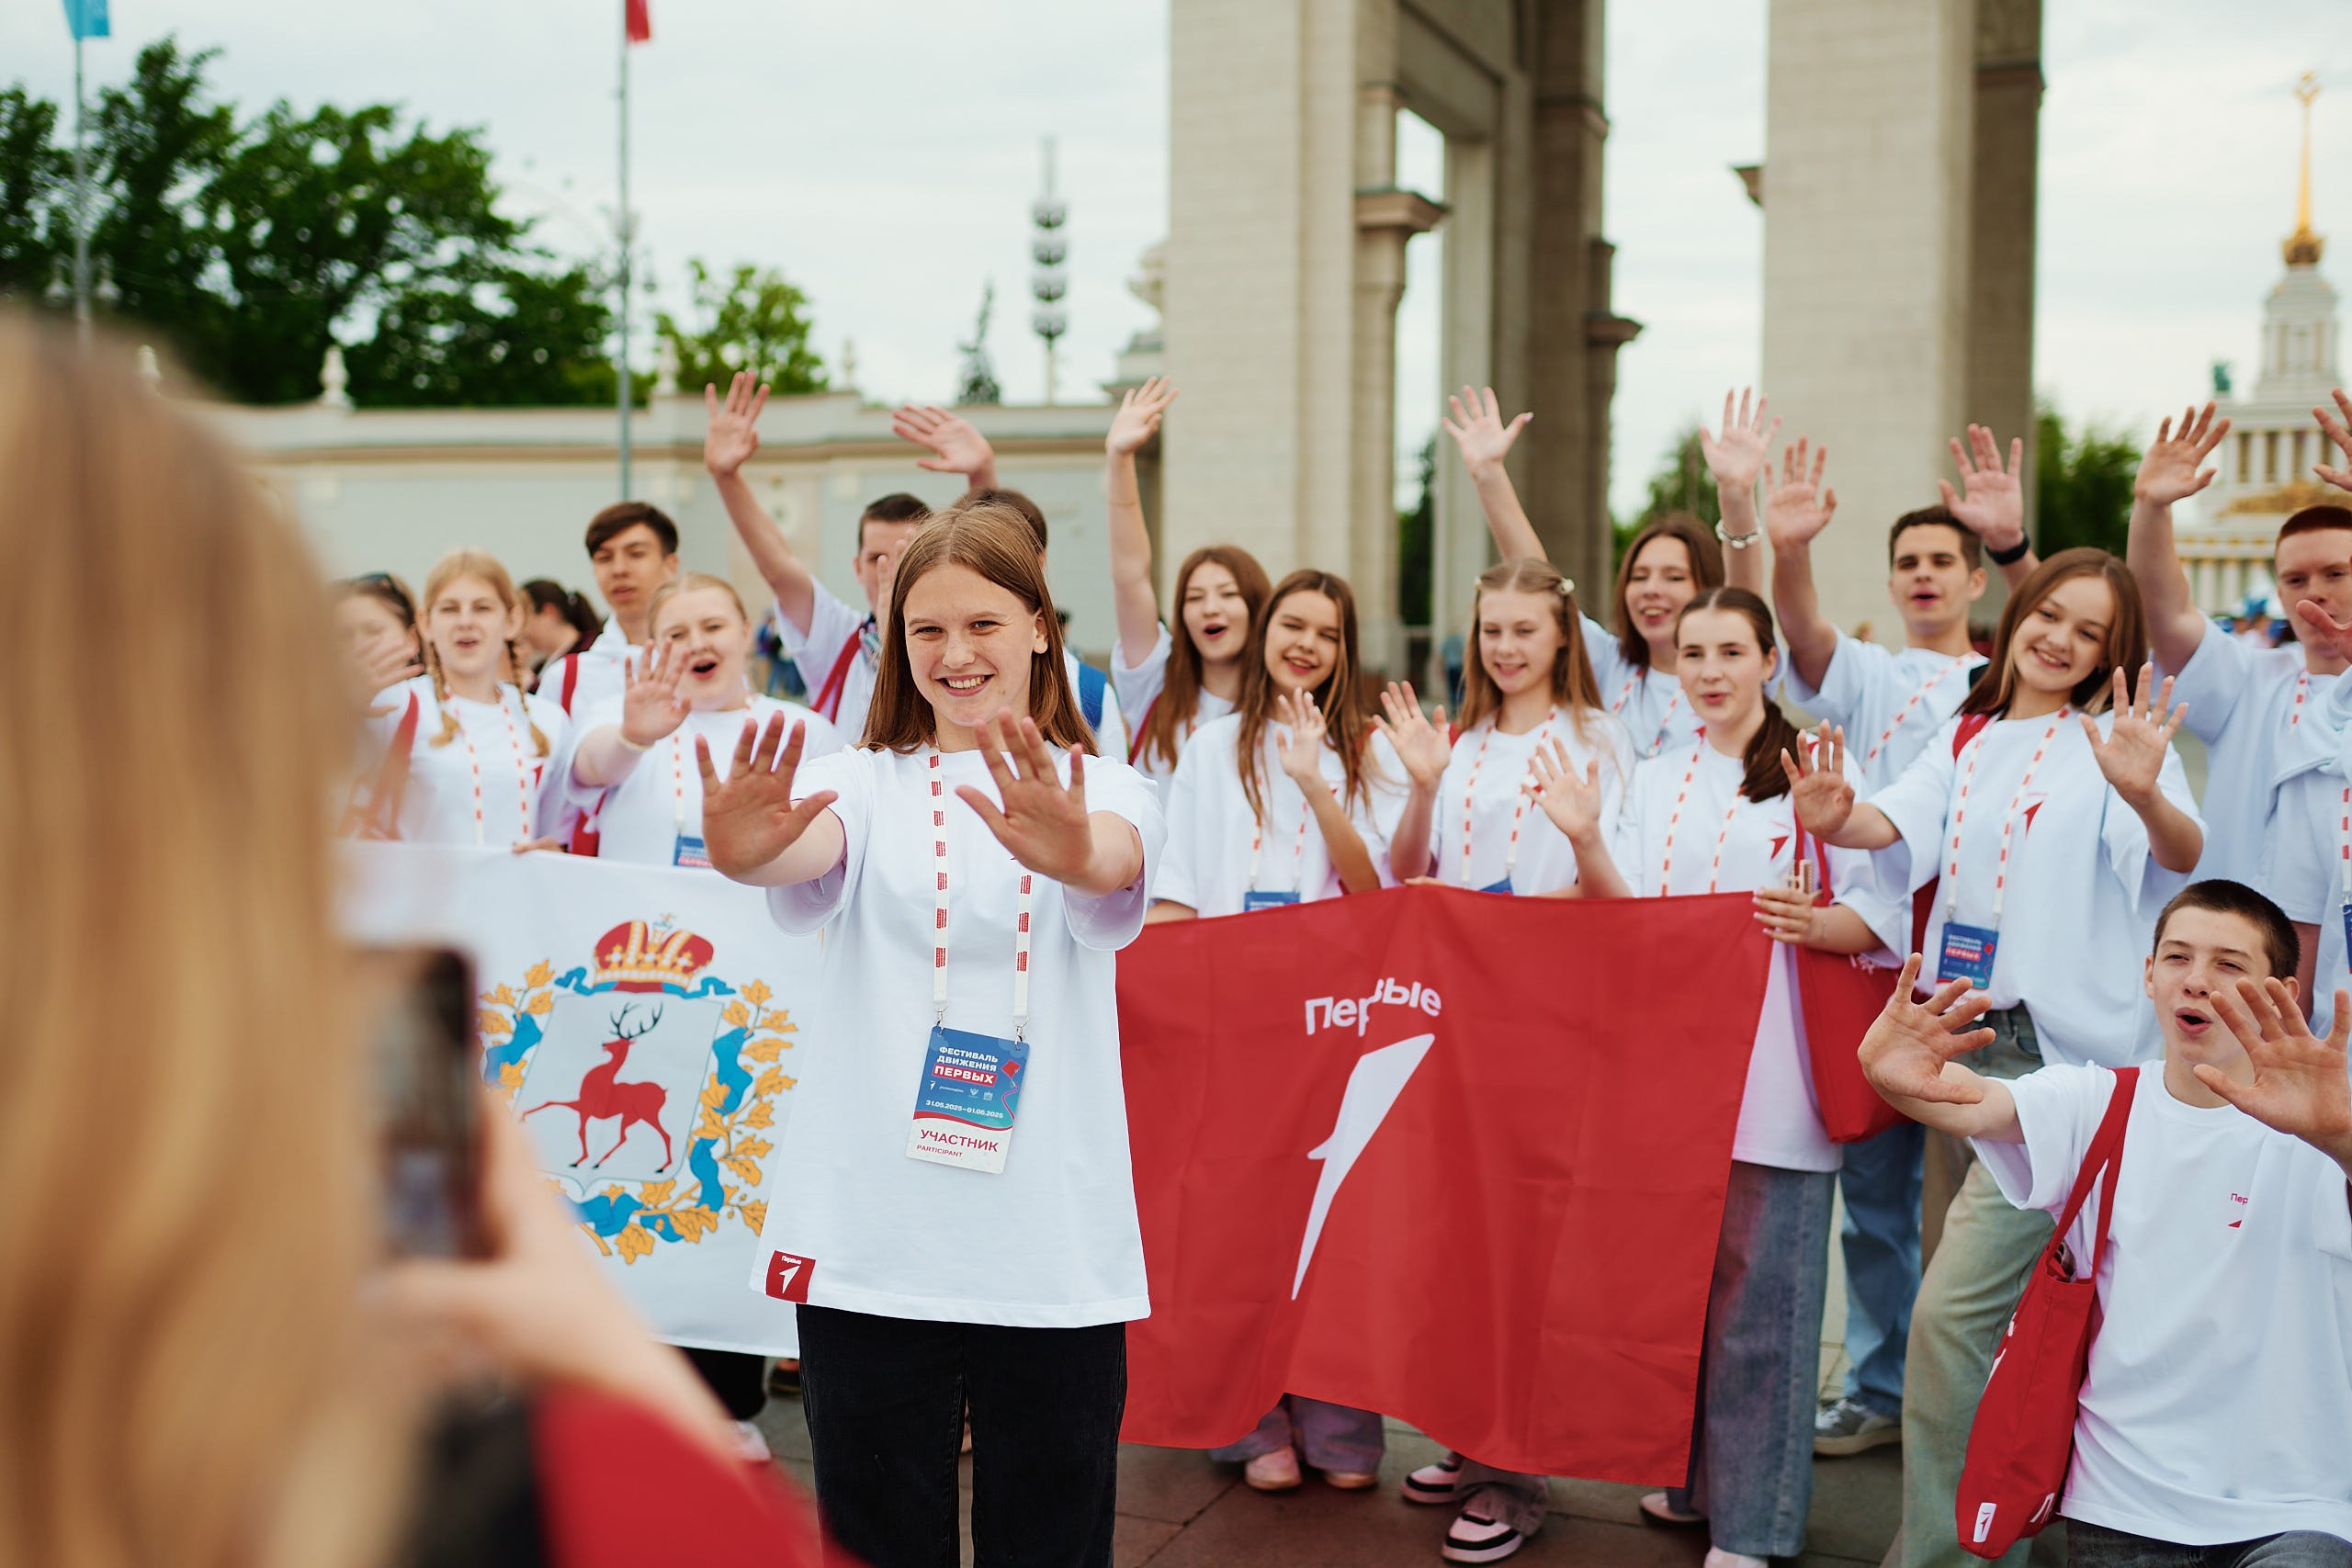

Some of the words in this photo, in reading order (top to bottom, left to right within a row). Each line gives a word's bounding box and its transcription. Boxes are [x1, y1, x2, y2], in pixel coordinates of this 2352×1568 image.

[939, 1046, 999, 1063] ФЕСТИВАЛЬ
[936, 1055, 998, 1072] ДВИЖЕНИЯ
[933, 1066, 994, 1084] ПЕРВЫХ
[921, 1129, 999, 1153] УЧАСТНИК
[916, 1145, 963, 1157] PARTICIPANT
